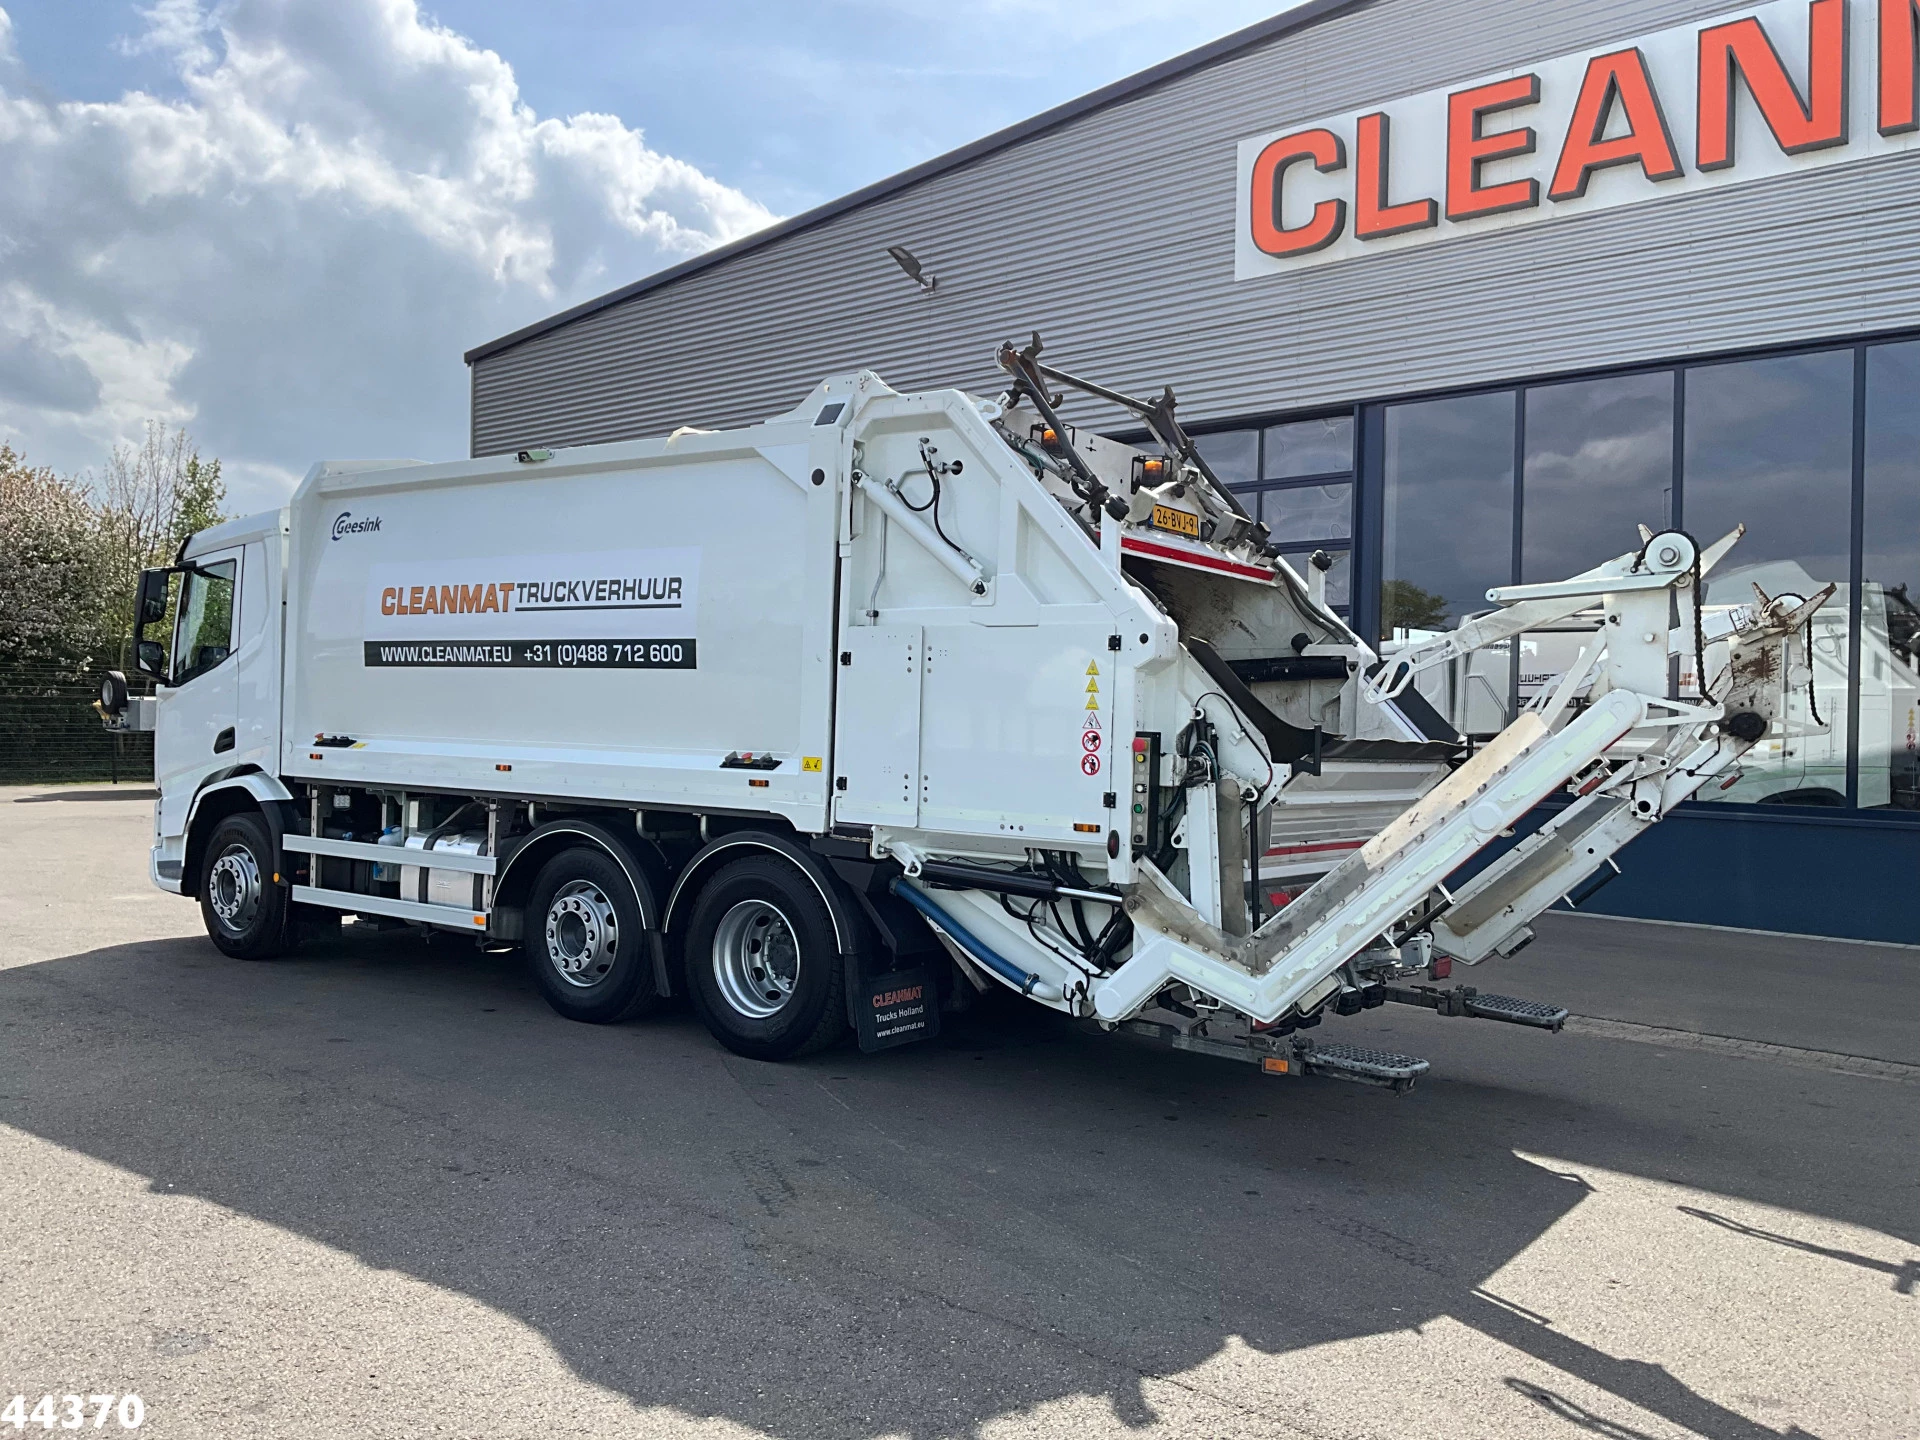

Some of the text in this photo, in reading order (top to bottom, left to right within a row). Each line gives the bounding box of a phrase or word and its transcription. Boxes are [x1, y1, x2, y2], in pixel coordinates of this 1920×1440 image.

[1250, 0, 1920, 259] CLEAN
[335, 515, 382, 536] Geesink
[381, 577, 682, 616] CLEANMAT TRUCKVERHUUR
[380, 644, 683, 665] WWW.CLEANMAT.EU +31 (0)488 712 600
[872, 985, 923, 1008] CLEANMAT
[876, 1004, 924, 1023] Trucks Holland
[876, 1021, 925, 1038] www.cleanmat.eu
